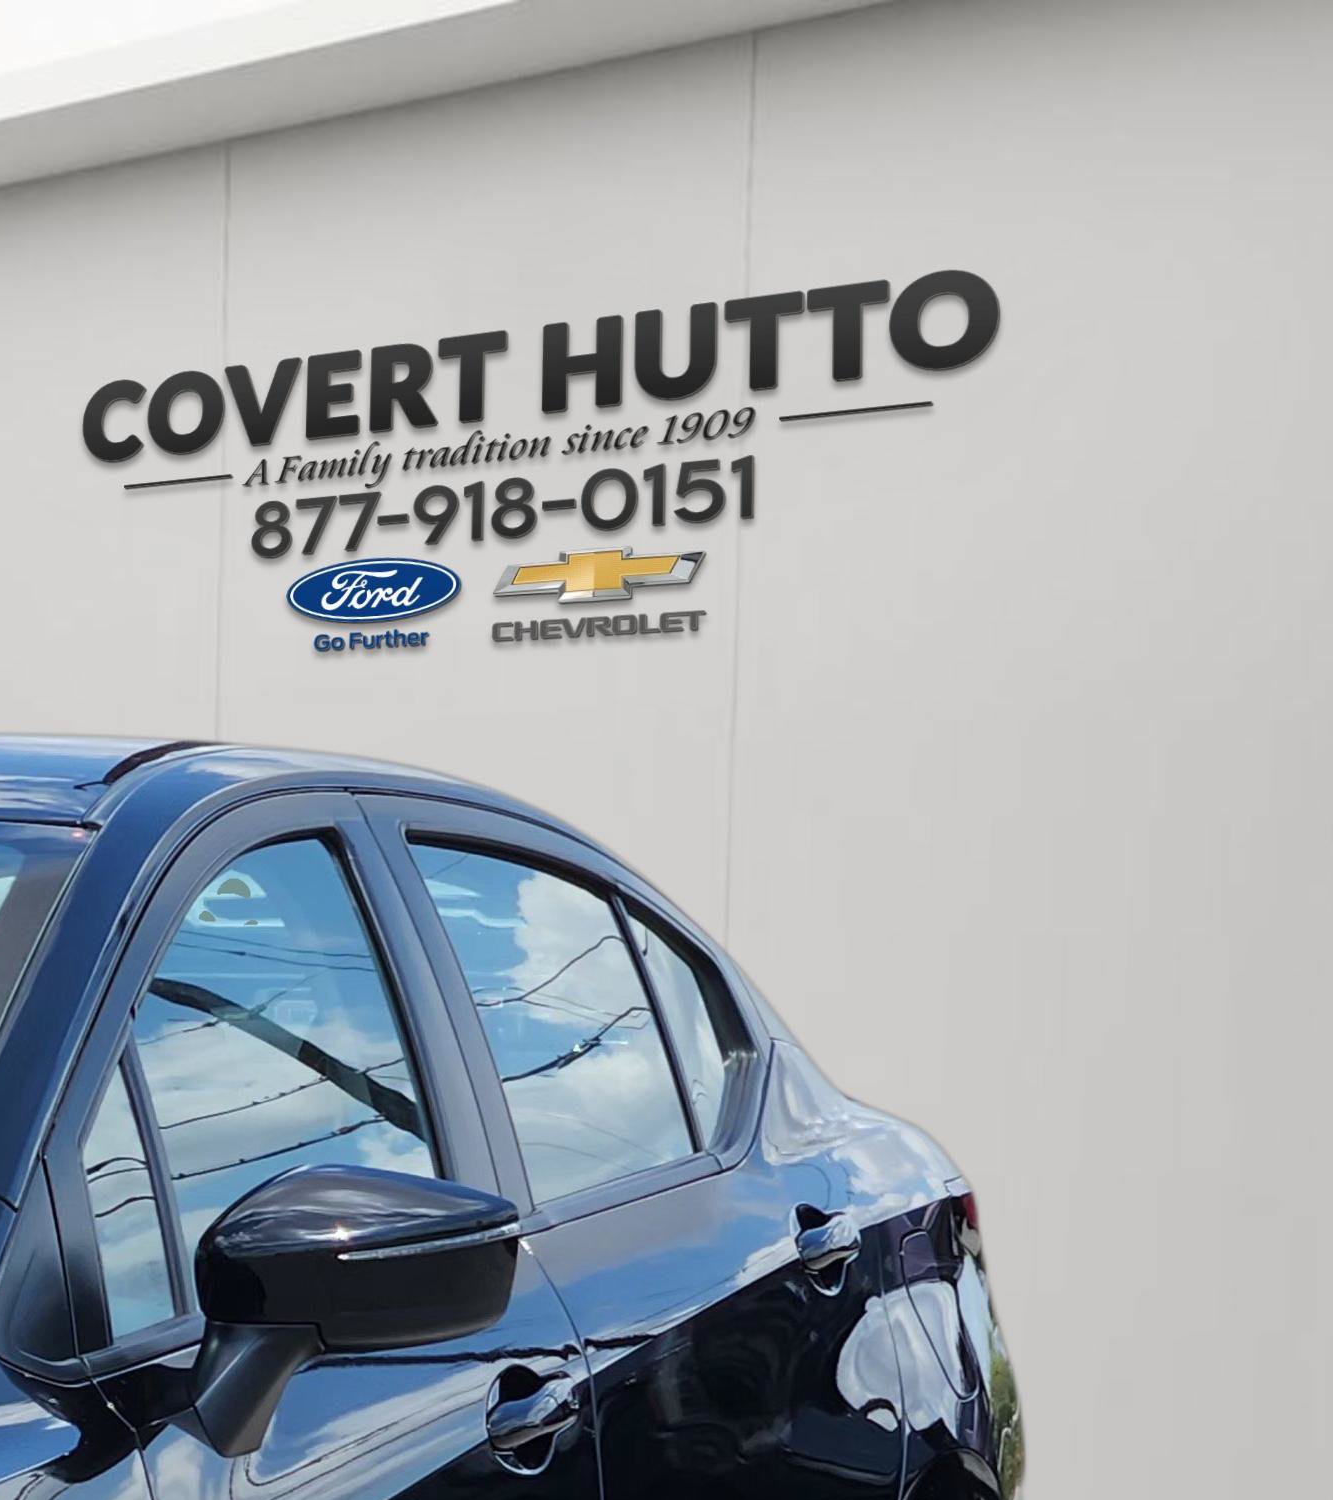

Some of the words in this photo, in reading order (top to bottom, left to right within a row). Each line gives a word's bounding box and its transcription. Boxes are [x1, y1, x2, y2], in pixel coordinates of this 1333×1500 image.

[82, 330, 509, 464] COVERT
[541, 269, 1001, 416] HUTTO
[274, 440, 393, 489] Family
[402, 429, 552, 472] tradition
[561, 424, 649, 456] since
[657, 406, 757, 446] 1909
[251, 454, 755, 560] 877-918-0151
[320, 569, 424, 611] Ford
[313, 634, 346, 653] Go
[348, 629, 431, 651] Further
[491, 610, 708, 643] CHEVROLET
